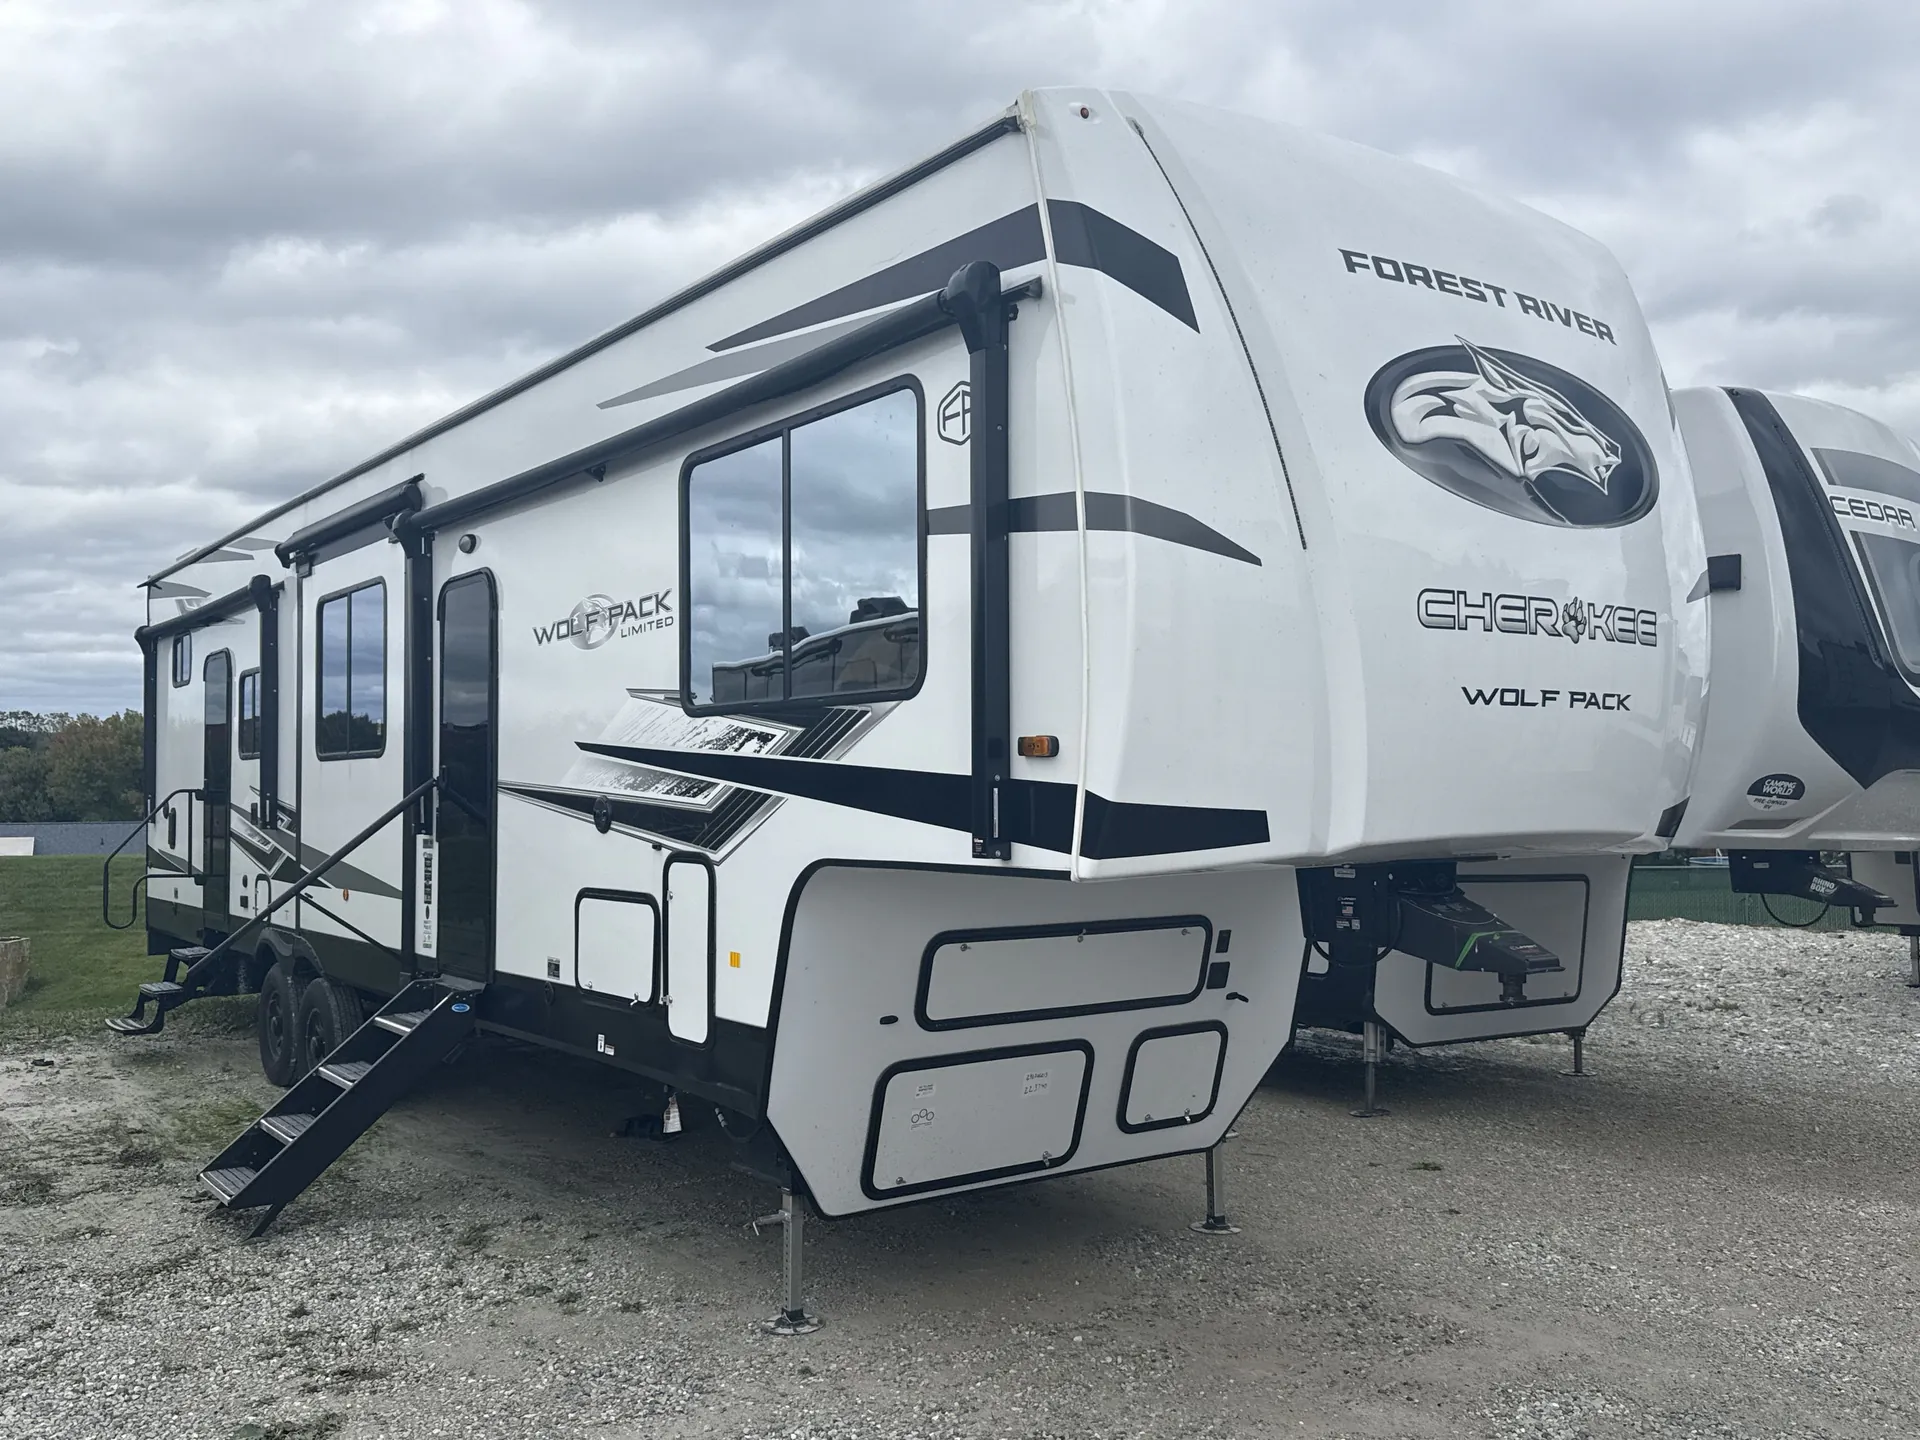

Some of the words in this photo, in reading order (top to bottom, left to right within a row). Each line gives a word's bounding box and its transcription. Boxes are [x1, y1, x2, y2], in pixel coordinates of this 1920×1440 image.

[1338, 248, 1507, 308] FOREST
[1513, 290, 1617, 346] RIVER
[1829, 495, 1916, 529] CEDAR
[532, 610, 601, 646] WOLF
[607, 588, 673, 627] PACK
[620, 615, 675, 639] LIMITED
[1461, 686, 1561, 708] WOLF
[1568, 690, 1632, 712] PACK
[1762, 785, 1793, 795] WORLD
[1765, 779, 1797, 789] CAMPING
[1810, 883, 1826, 894] BOX
[1812, 876, 1836, 889] RHINO
